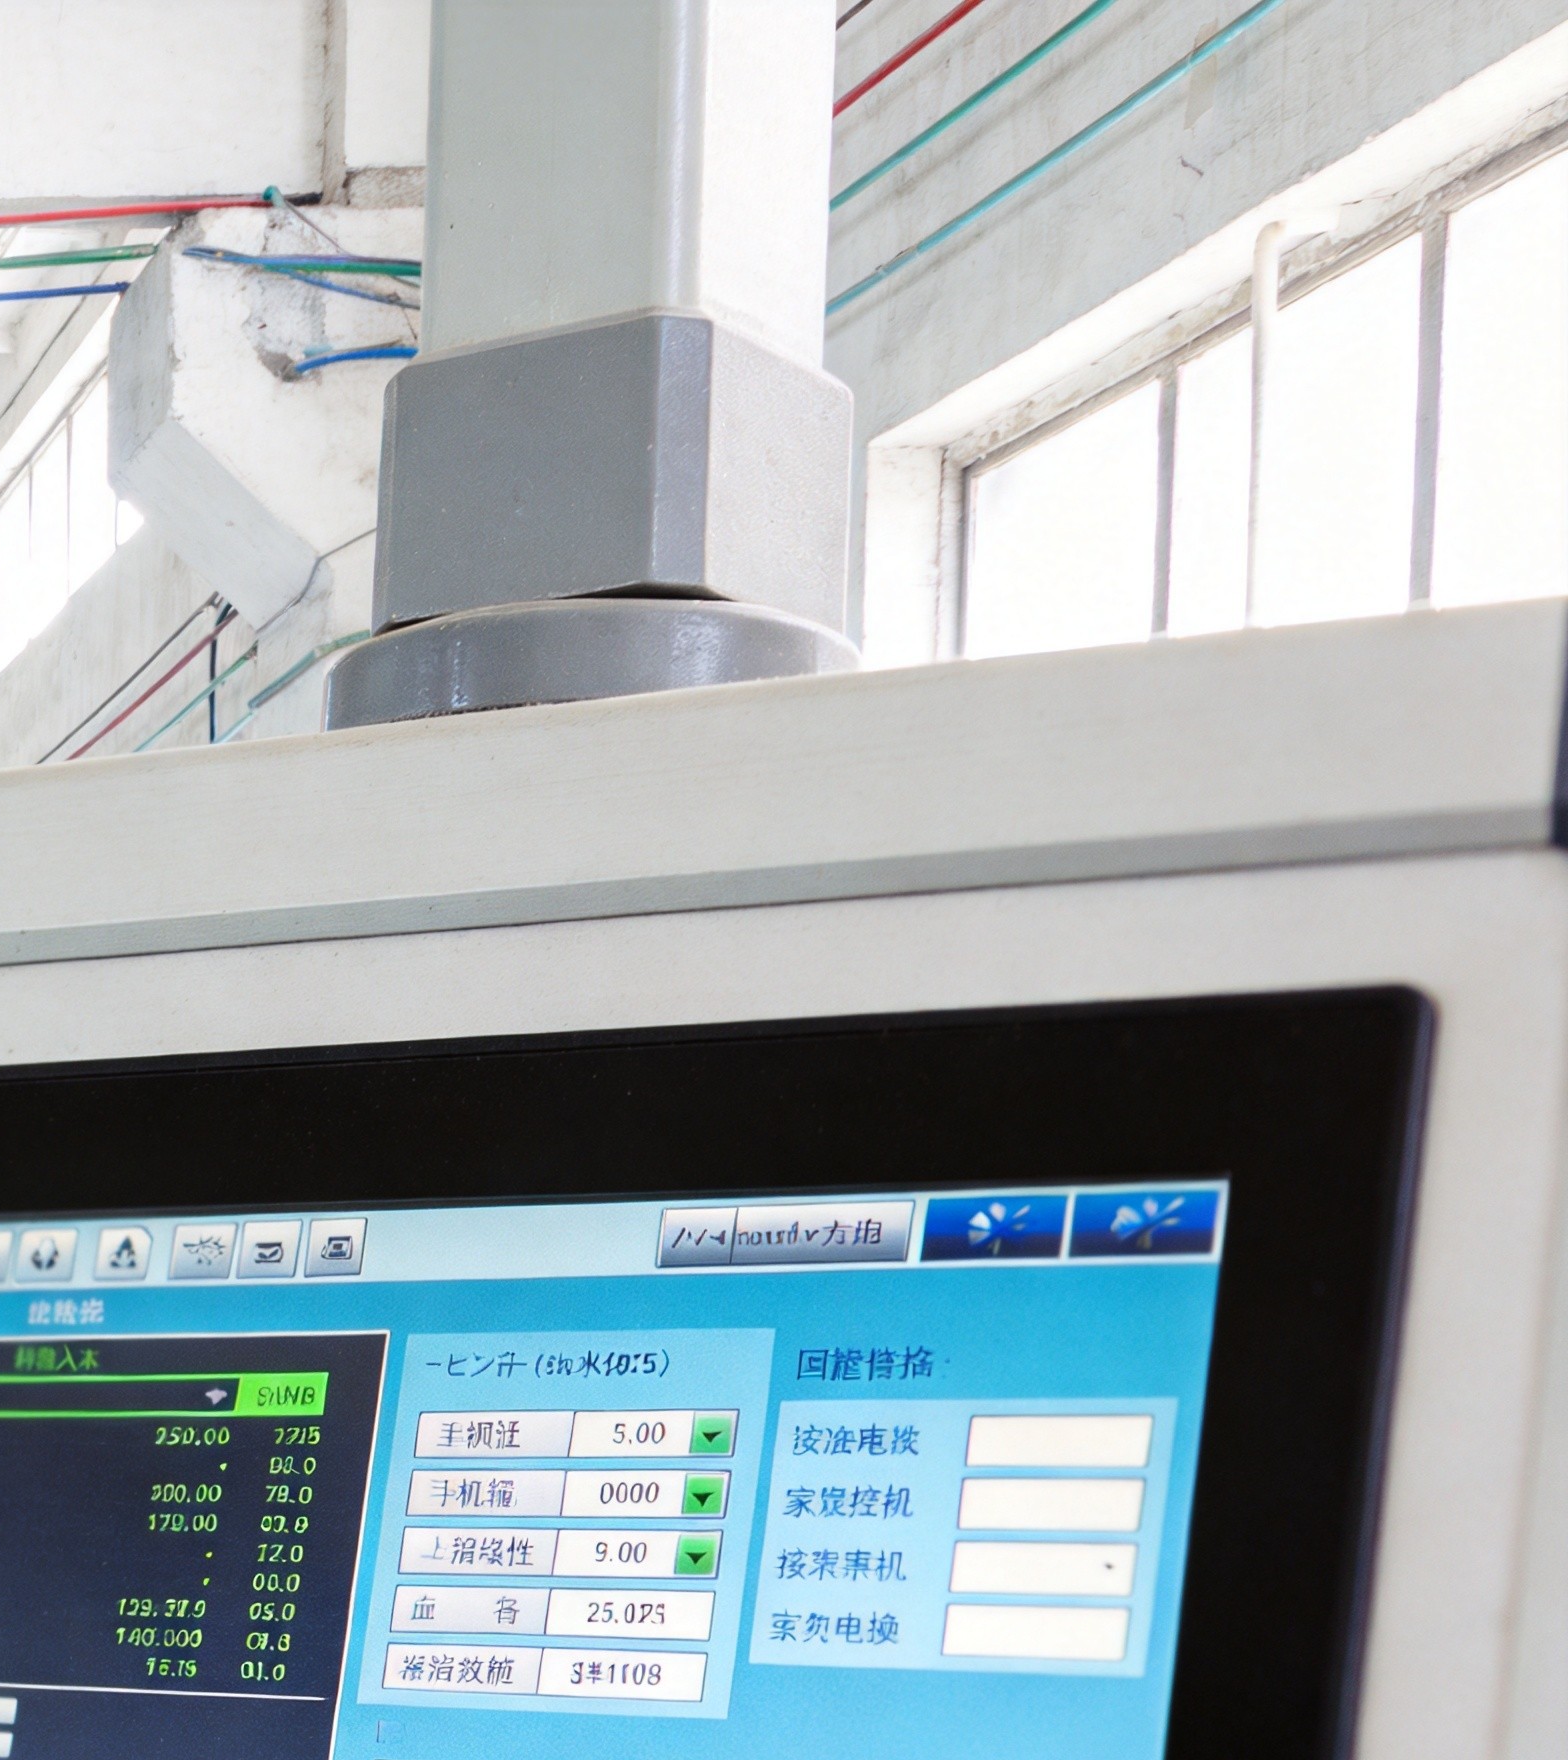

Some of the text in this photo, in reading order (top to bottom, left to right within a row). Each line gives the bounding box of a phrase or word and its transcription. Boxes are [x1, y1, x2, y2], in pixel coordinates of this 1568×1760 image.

[612, 1421, 666, 1445] 5.00
[599, 1481, 660, 1504] 0000
[595, 1541, 648, 1563] 9.00
